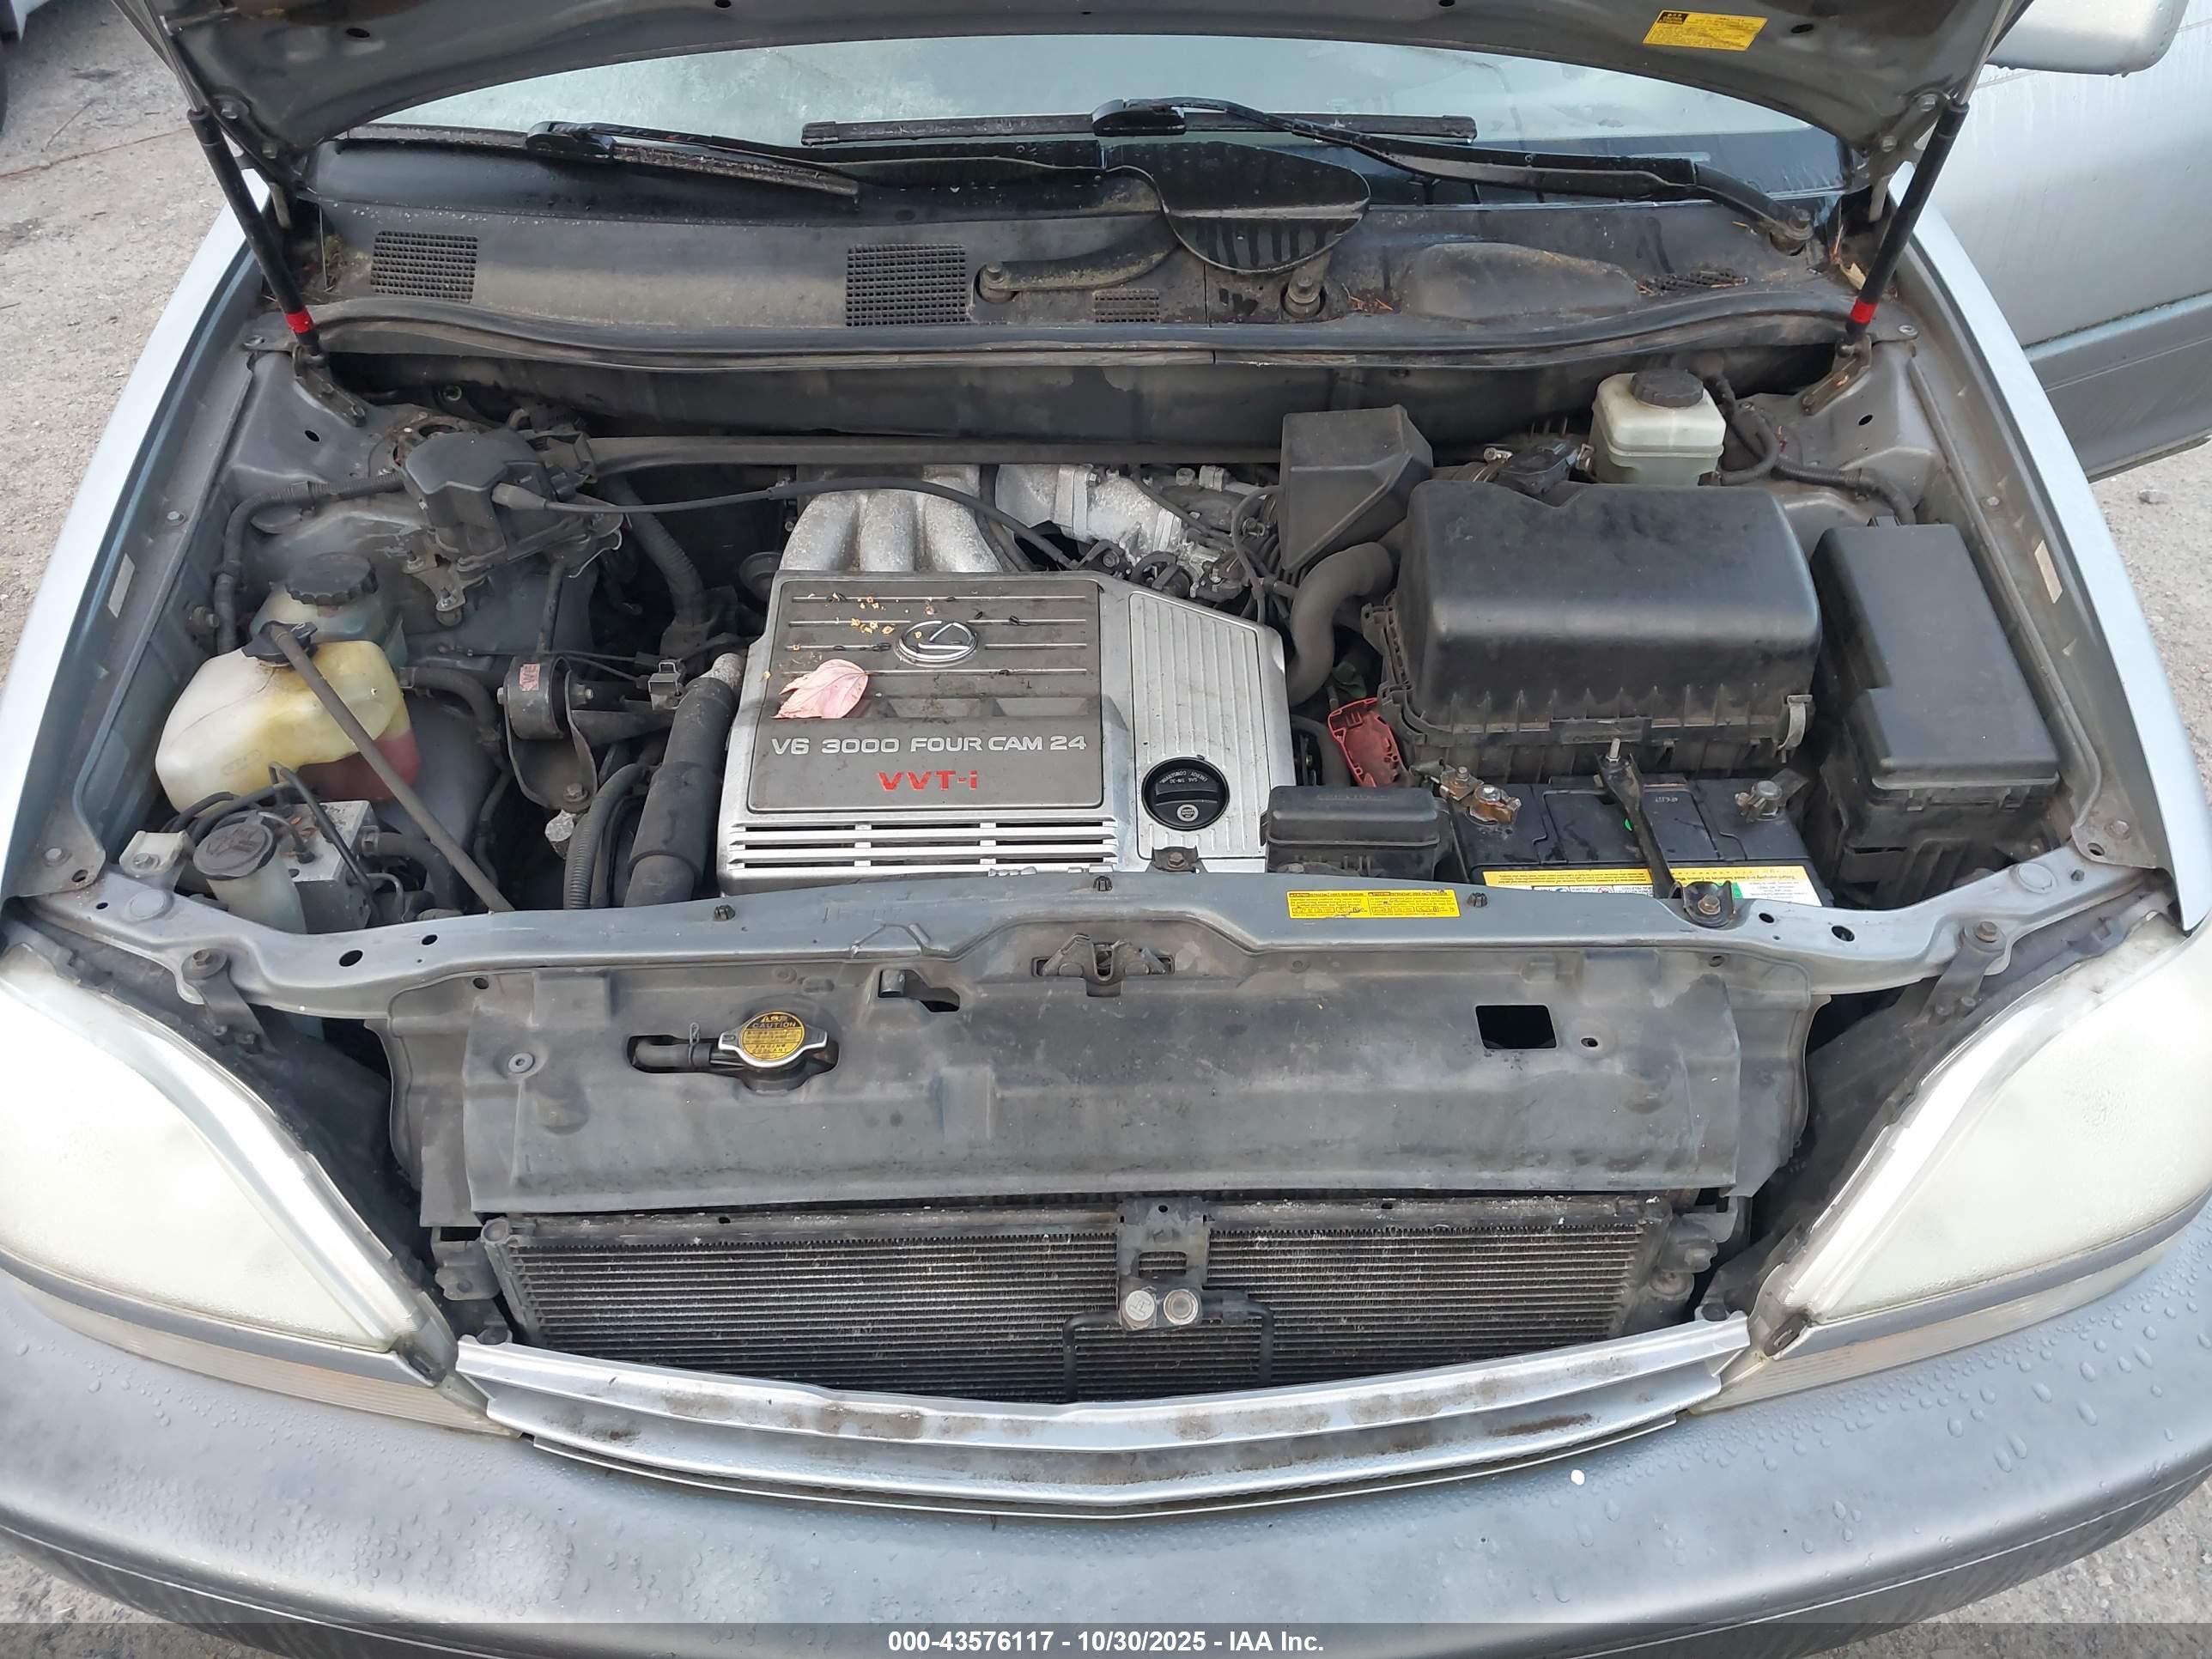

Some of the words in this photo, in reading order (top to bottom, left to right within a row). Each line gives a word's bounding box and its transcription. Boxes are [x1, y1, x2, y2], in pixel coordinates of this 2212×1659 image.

[771, 738, 810, 755] V6
[821, 738, 900, 754] 3000
[910, 735, 983, 752] FOUR
[988, 735, 1043, 751] CAM
[1049, 735, 1087, 750] 24
[878, 769, 978, 791] VVT-i
